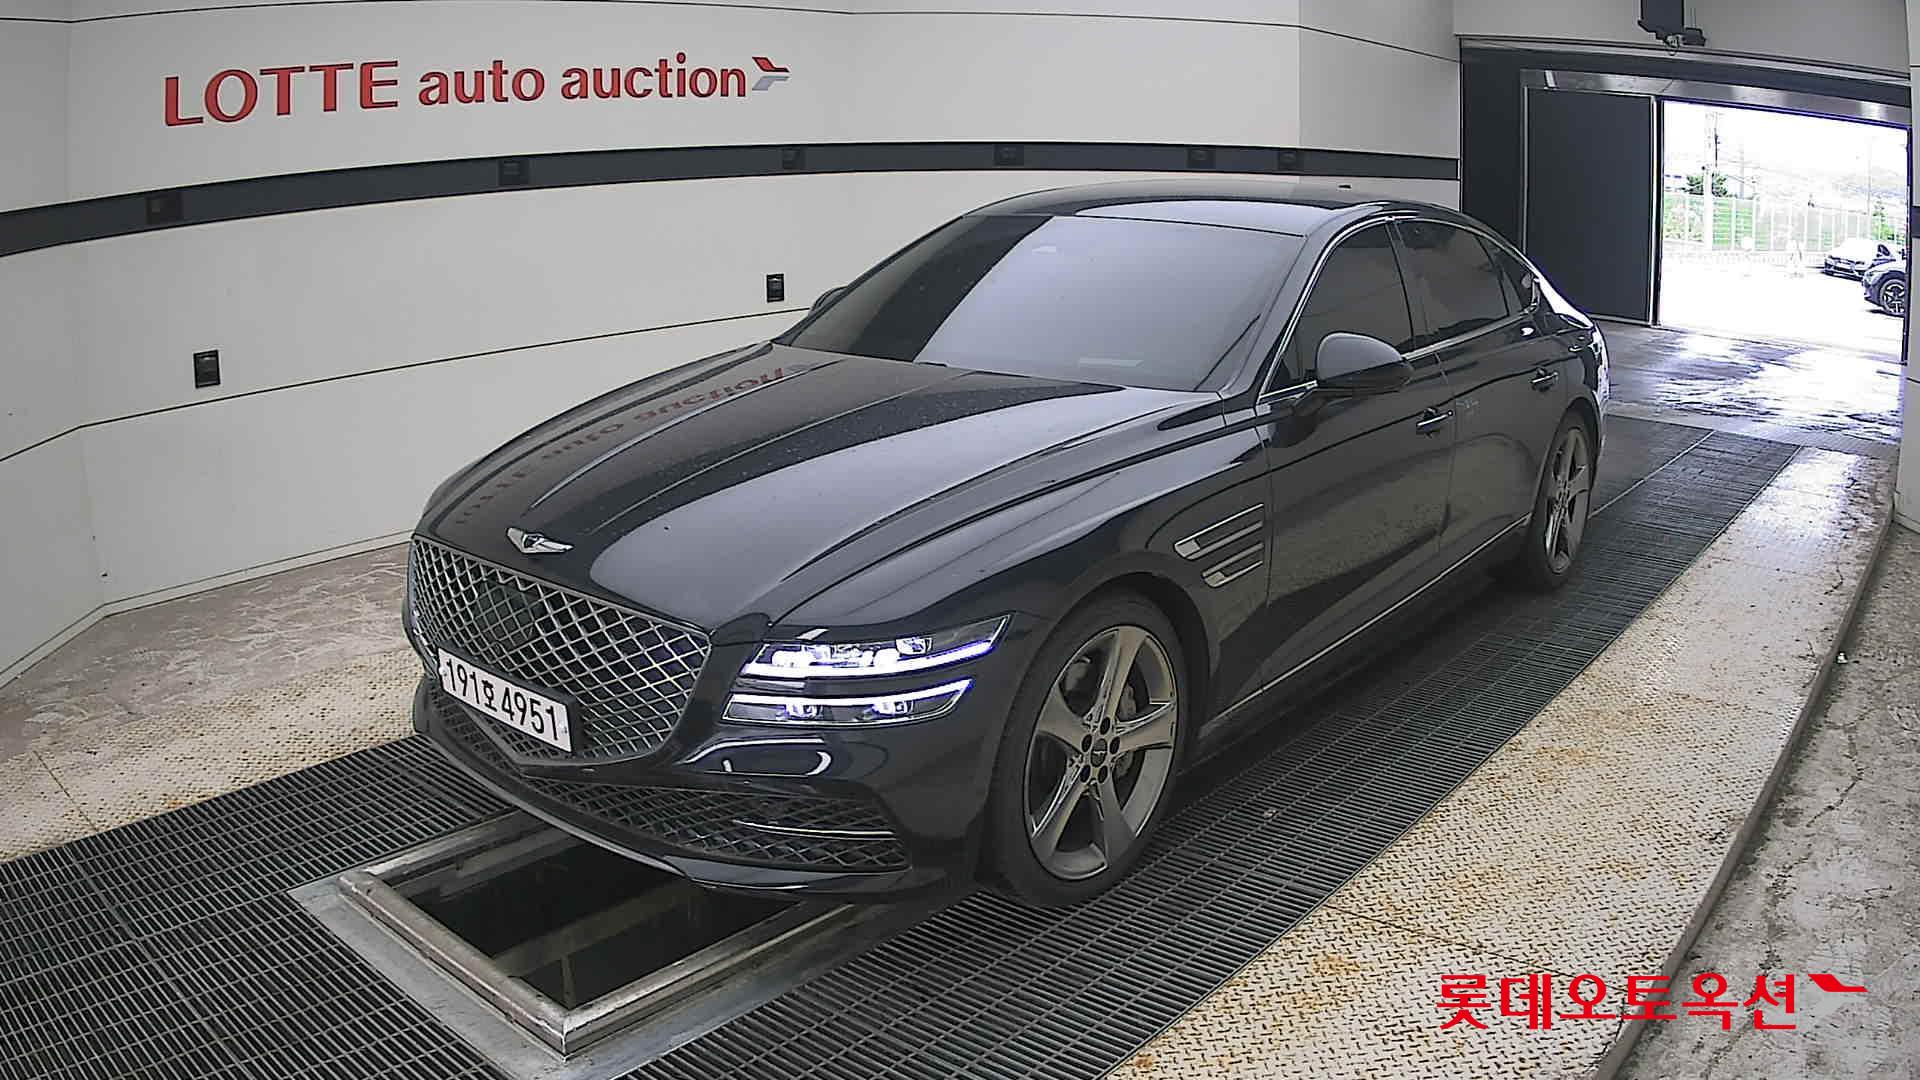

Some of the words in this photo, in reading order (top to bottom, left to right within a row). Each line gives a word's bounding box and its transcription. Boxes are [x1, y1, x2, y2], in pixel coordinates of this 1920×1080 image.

[164, 61, 398, 127] LOTTE
[418, 59, 546, 105] auto
[560, 52, 747, 99] auction
